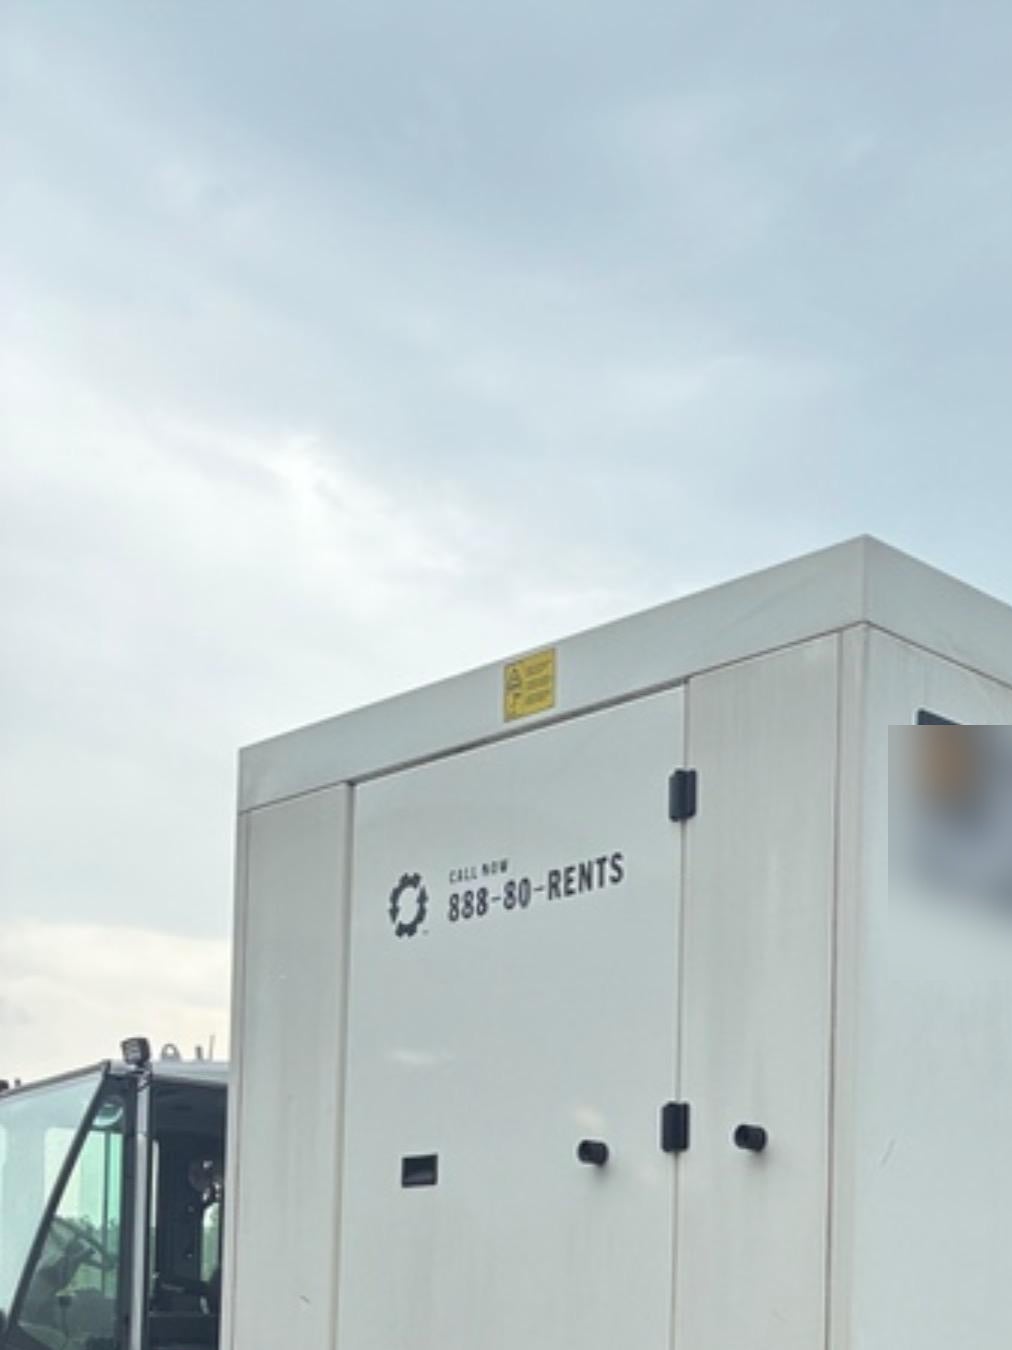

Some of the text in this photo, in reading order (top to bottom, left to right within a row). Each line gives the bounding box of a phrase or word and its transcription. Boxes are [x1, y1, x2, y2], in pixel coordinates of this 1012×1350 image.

[448, 858, 509, 885] CALL NOW
[448, 851, 625, 923] 888-80-RENTS
